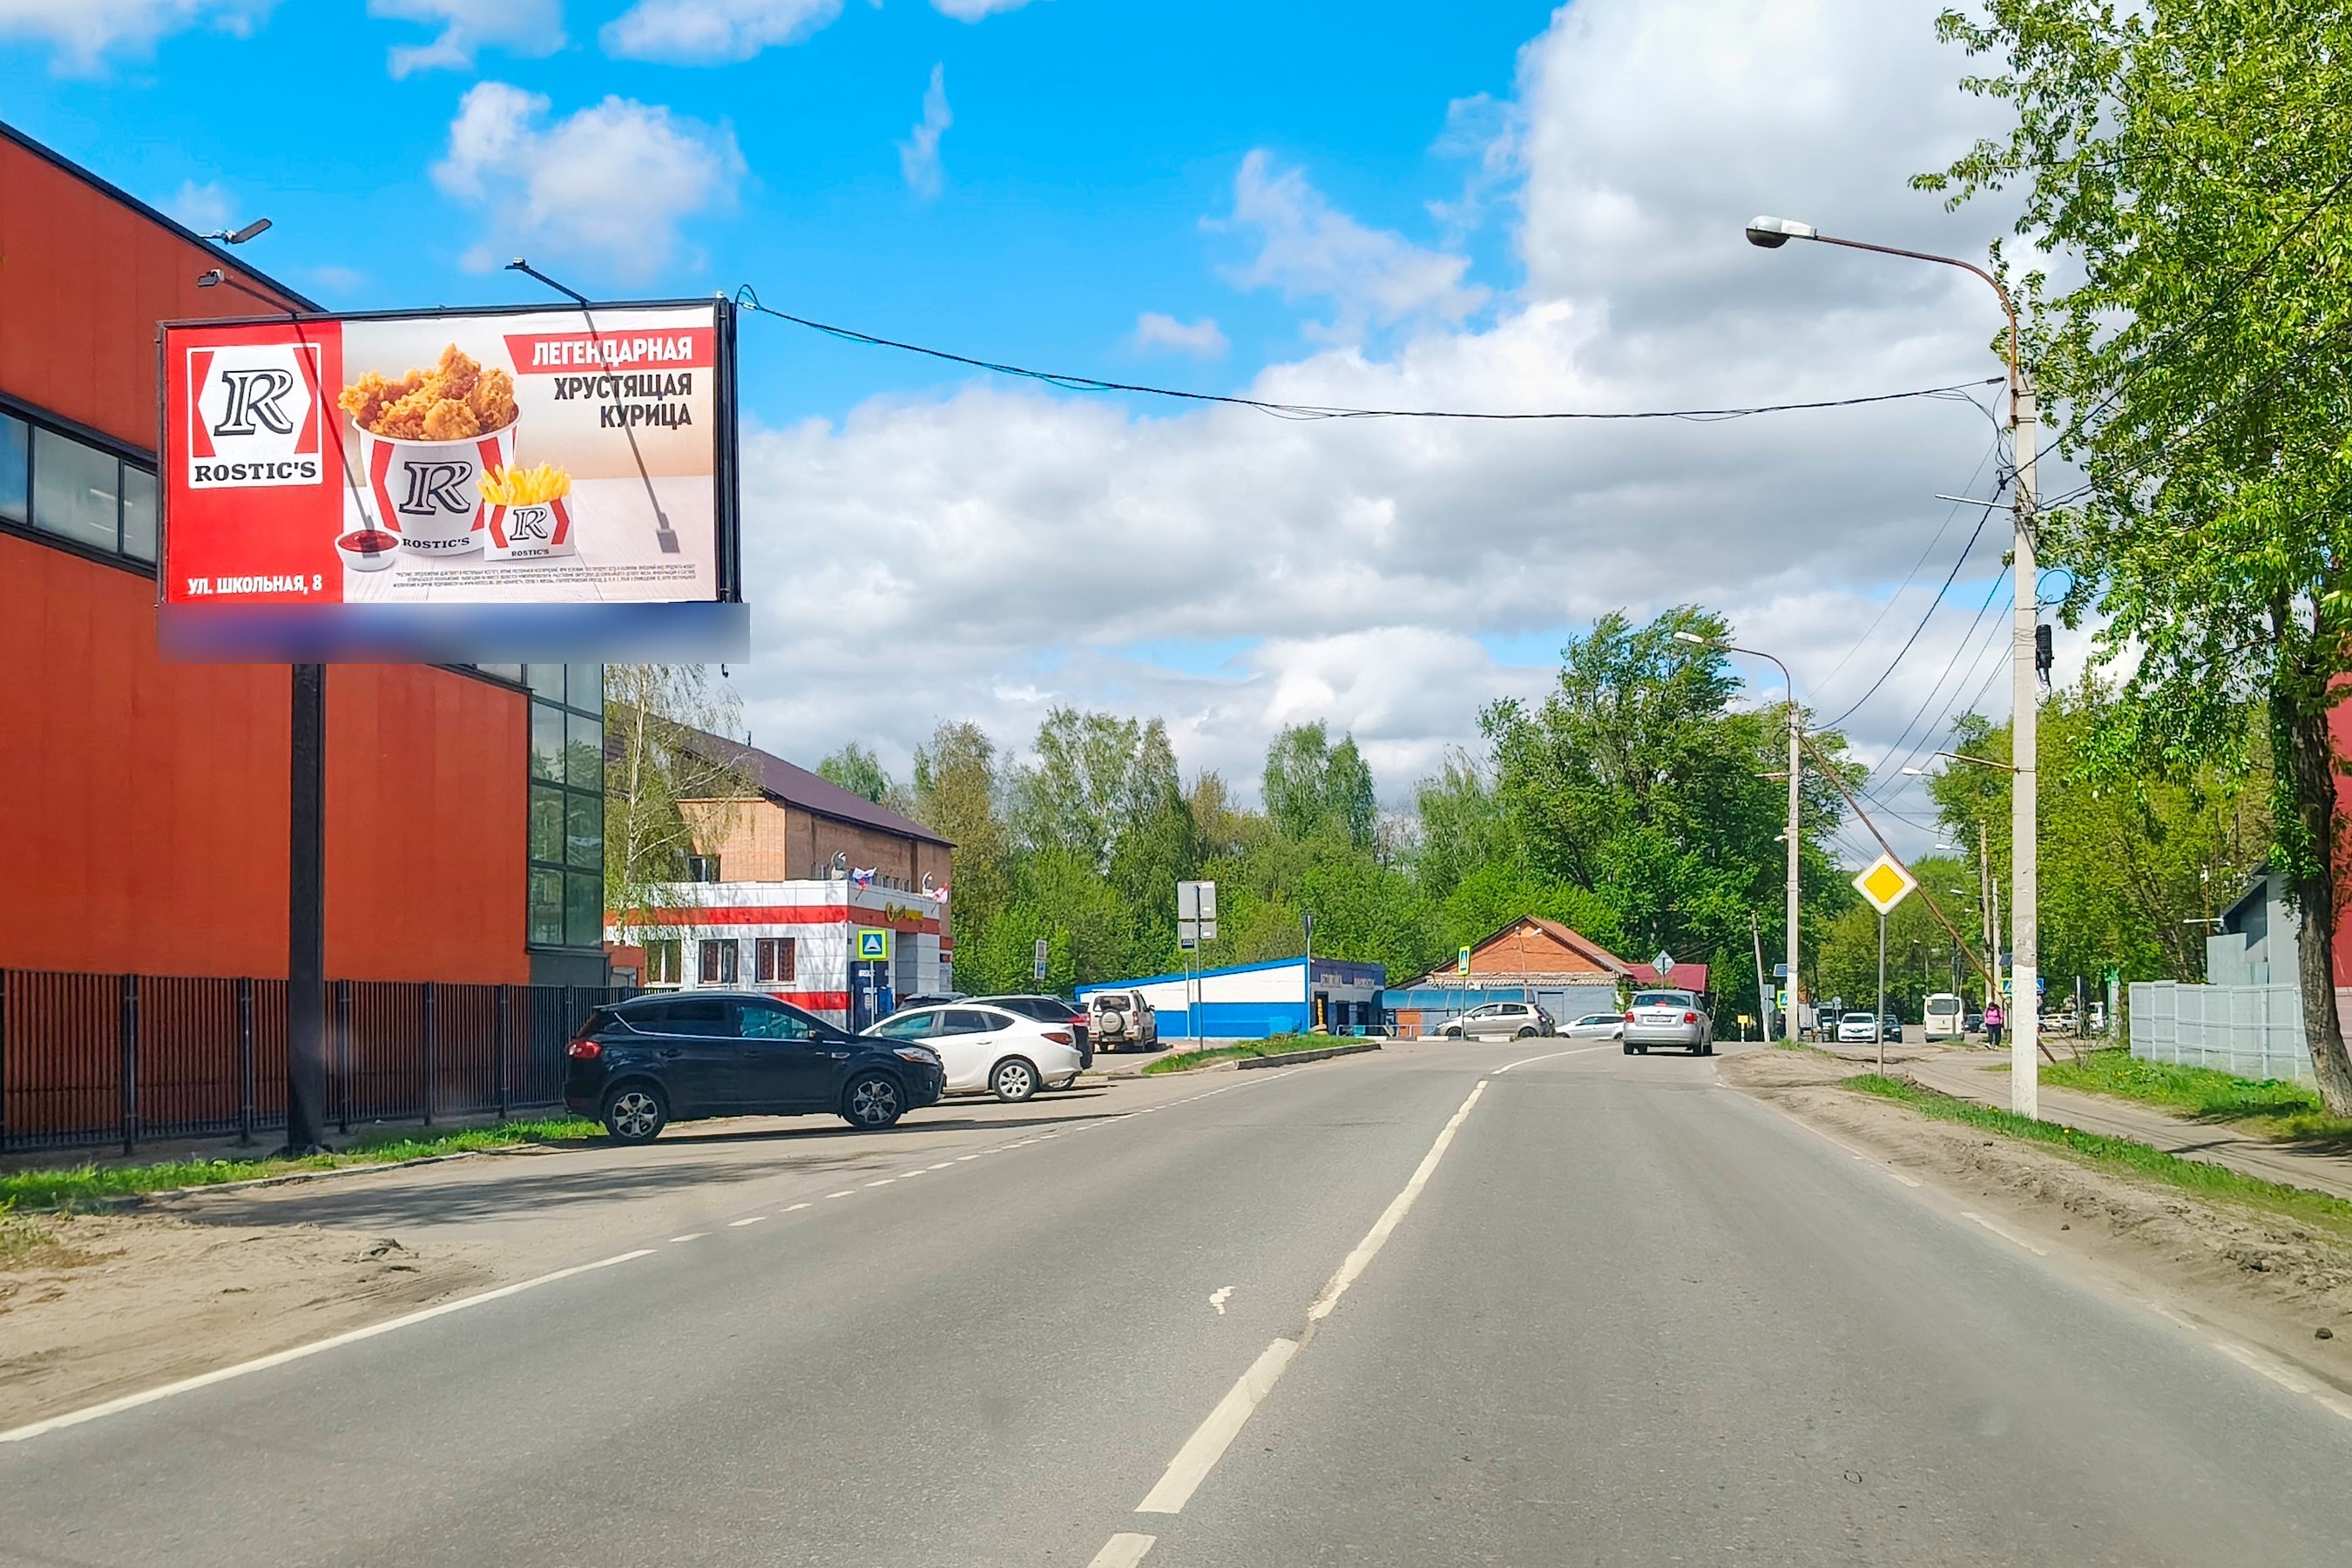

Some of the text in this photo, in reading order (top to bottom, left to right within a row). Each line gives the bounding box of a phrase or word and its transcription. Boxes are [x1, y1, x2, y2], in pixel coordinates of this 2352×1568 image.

[532, 336, 693, 368] ЛЕГЕНДАРНАЯ
[554, 373, 693, 401] ХРУСТЯЩАЯ
[600, 403, 693, 430] КУРИЦА
[194, 461, 316, 482] ROSTIC'S
[402, 537, 470, 549] ROSTIC'S
[511, 548, 550, 557] ROSTIC'S
[187, 574, 323, 595] УЛ. ШКОЛЬНАЯ, 8
